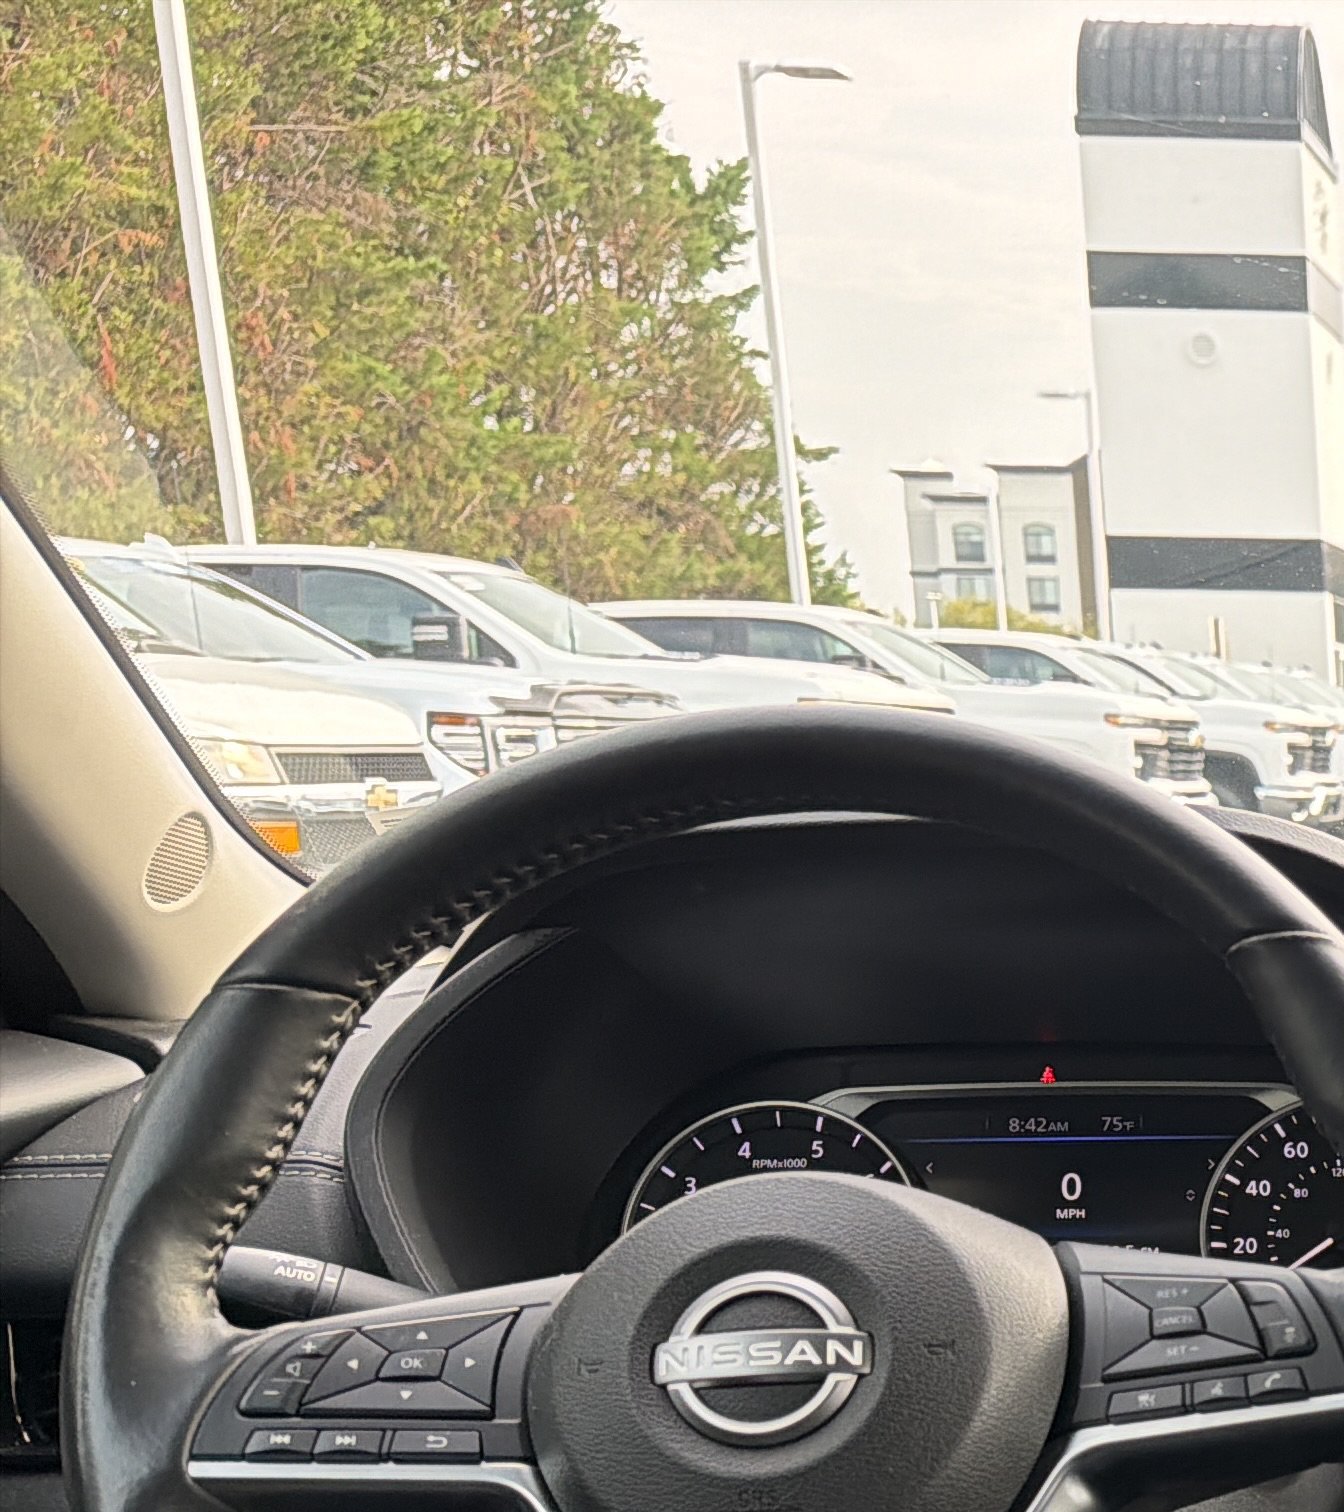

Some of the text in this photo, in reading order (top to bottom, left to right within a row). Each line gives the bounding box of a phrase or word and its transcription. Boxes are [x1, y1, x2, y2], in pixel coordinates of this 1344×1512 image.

[737, 1141, 751, 1159] 4
[811, 1140, 824, 1158] 5
[1283, 1142, 1309, 1159] 60
[684, 1177, 697, 1195] 3
[1061, 1172, 1082, 1201] 0
[1245, 1180, 1271, 1197] 40
[1294, 1188, 1308, 1198] 80
[1055, 1208, 1086, 1220] MPH
[1275, 1228, 1290, 1239] 40
[1233, 1237, 1258, 1254] 20
[274, 1265, 316, 1282] AUTO
[400, 1358, 424, 1369] OK
[658, 1339, 864, 1377] NISSAN
